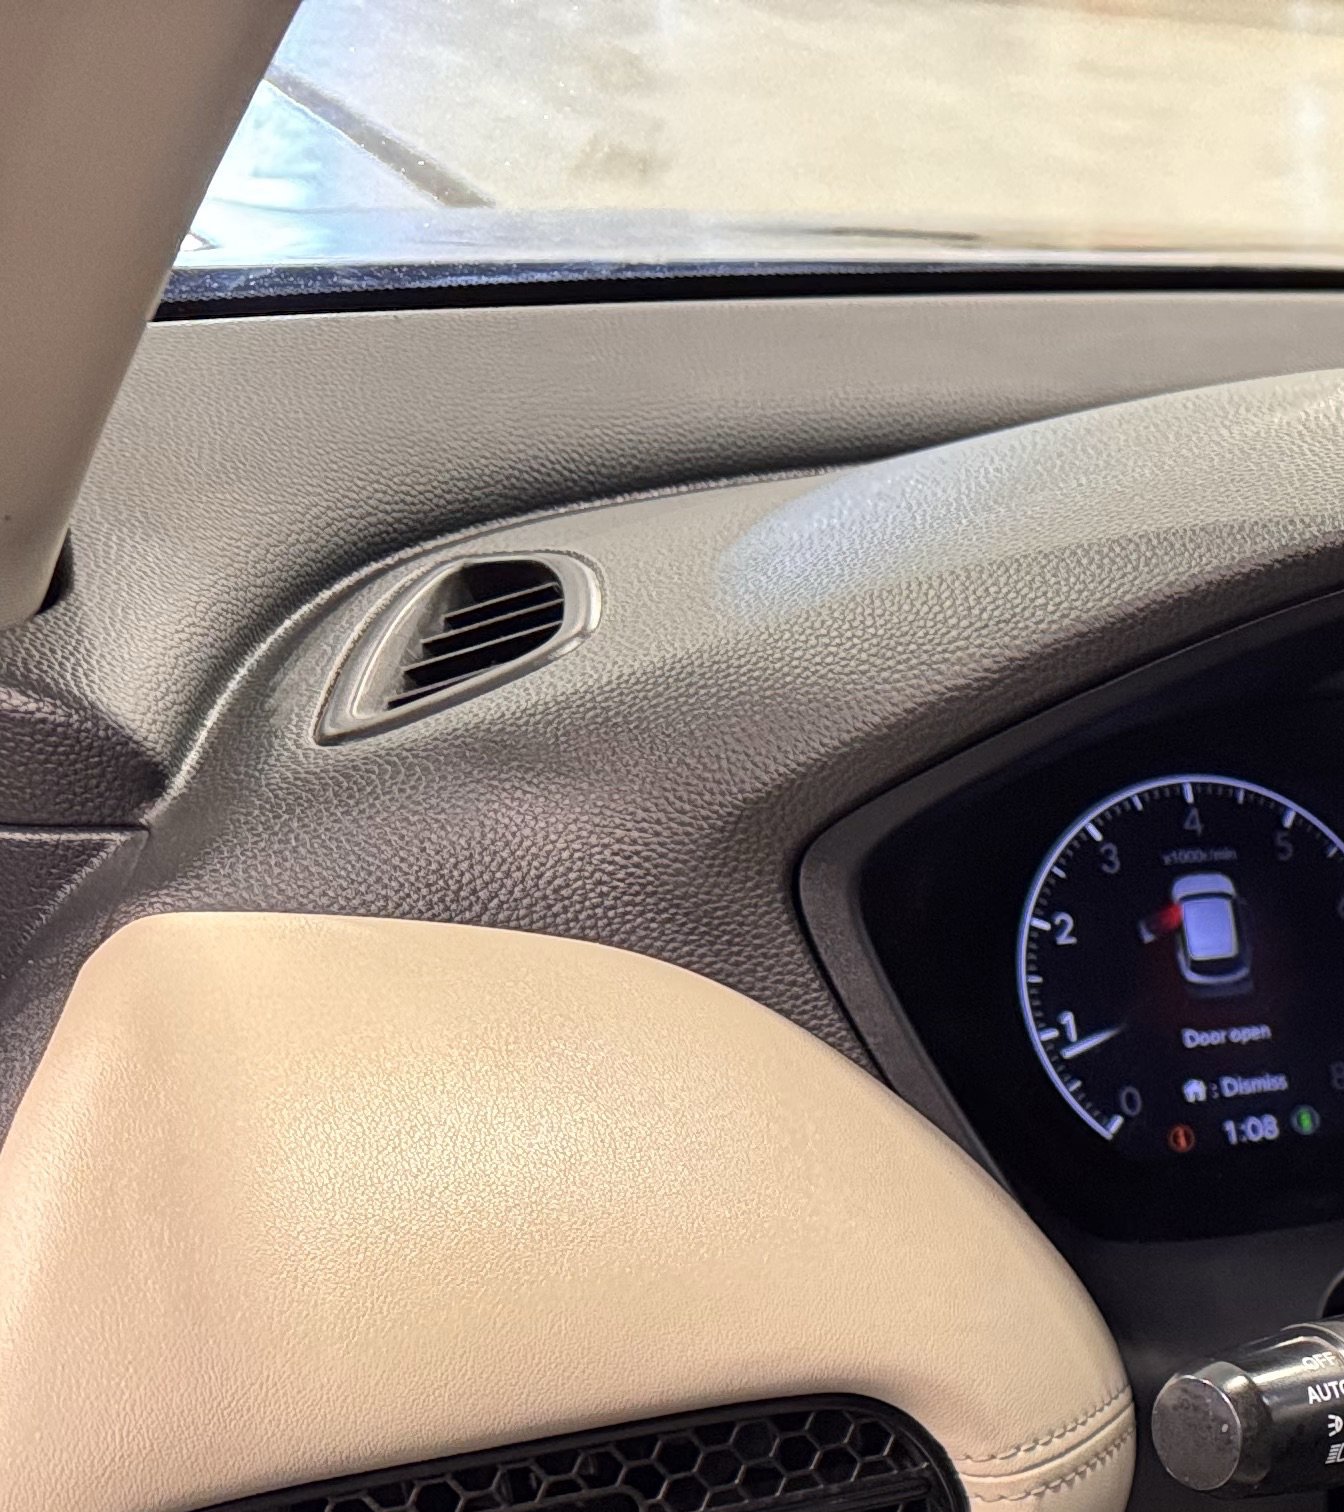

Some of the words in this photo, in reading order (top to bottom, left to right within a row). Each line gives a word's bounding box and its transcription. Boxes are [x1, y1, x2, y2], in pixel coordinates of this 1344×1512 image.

[1184, 808, 1202, 835] 4
[1101, 843, 1121, 875] 3
[1275, 832, 1294, 861] 5
[1053, 912, 1077, 946] 2
[1058, 1010, 1078, 1043] 1
[1182, 1026, 1227, 1049] Door
[1229, 1024, 1272, 1047] open
[1221, 1072, 1289, 1098] Dismiss
[1119, 1086, 1143, 1117] 0
[1222, 1115, 1281, 1146] 1:08
[1301, 1351, 1336, 1371] OFF
